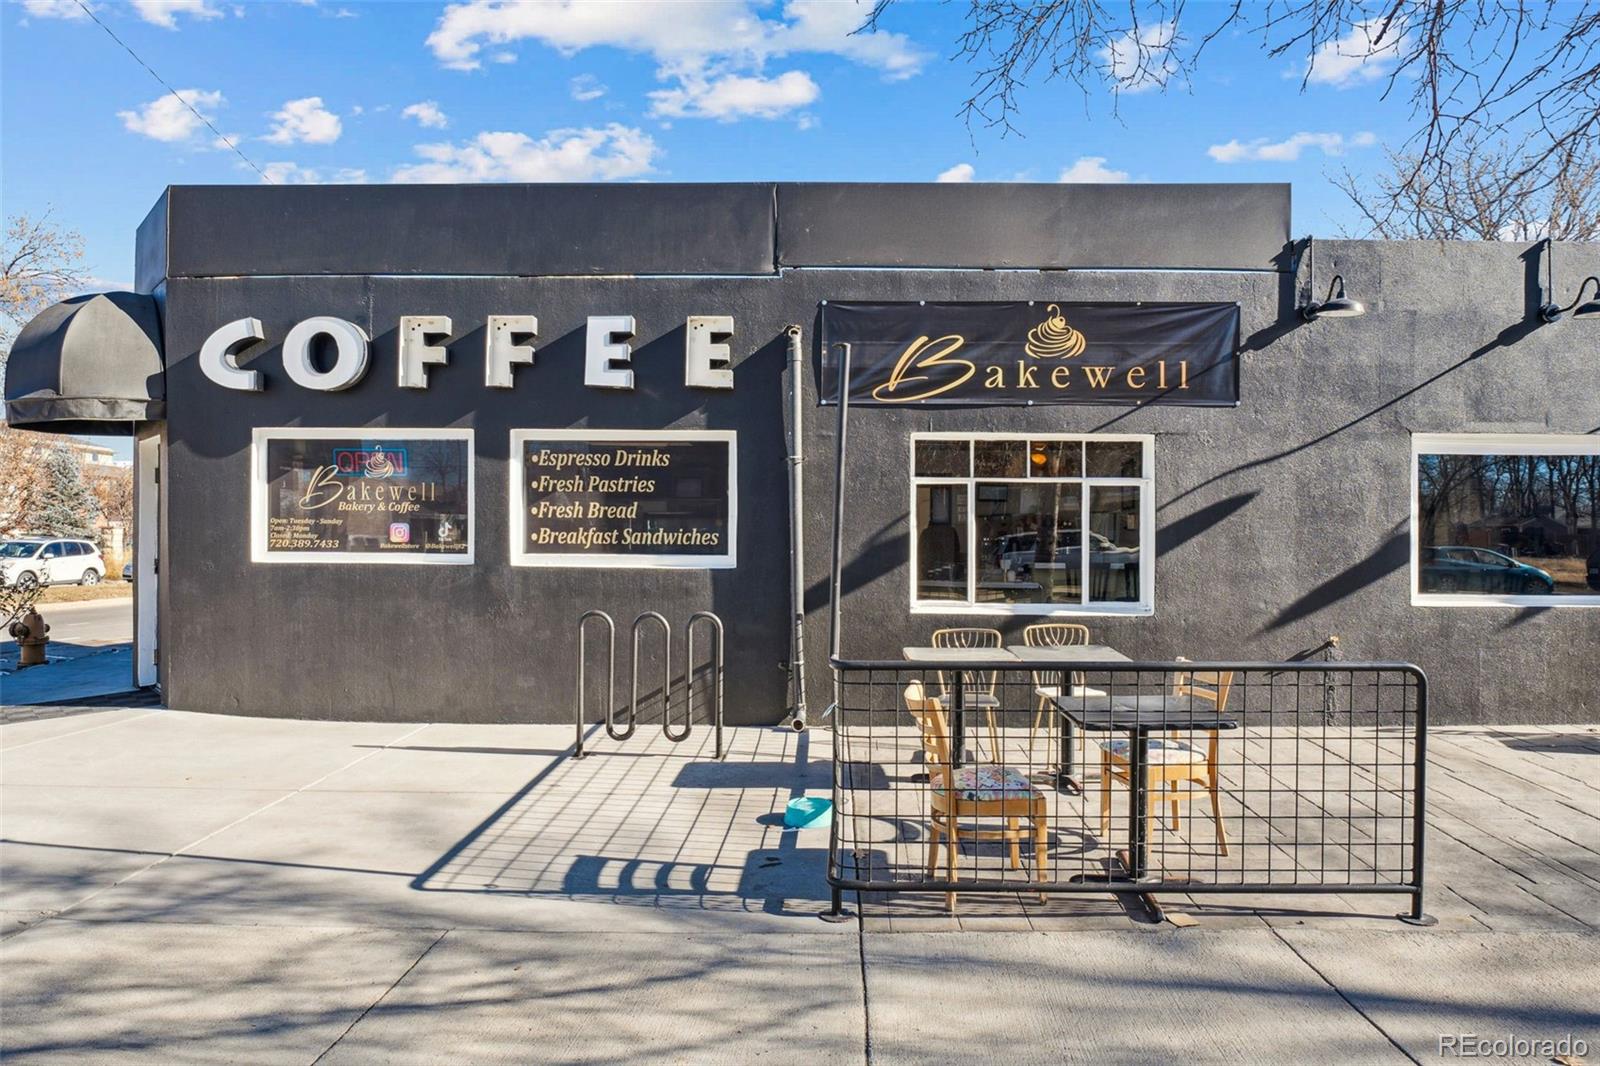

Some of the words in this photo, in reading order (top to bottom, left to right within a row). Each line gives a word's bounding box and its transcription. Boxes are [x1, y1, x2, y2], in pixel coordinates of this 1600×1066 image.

[198, 315, 736, 392] COFFEE
[872, 334, 1190, 402] Bakewell
[337, 451, 403, 473] OPN
[538, 449, 610, 470] Espresso
[614, 449, 670, 467] Drinks
[298, 464, 435, 510] Bakewell
[538, 475, 584, 493] Fresh
[587, 475, 655, 493] Pastries
[338, 501, 375, 514] Bakery
[377, 502, 386, 511] &
[388, 501, 421, 514] Coffee
[538, 501, 584, 519] Fresh
[587, 501, 638, 519] Bread
[289, 517, 315, 526] Tuesday
[319, 517, 343, 526] Sunday
[270, 539, 340, 548] 720.389.7433
[537, 528, 619, 549] Breakfast
[621, 528, 719, 546] Sandwiches
